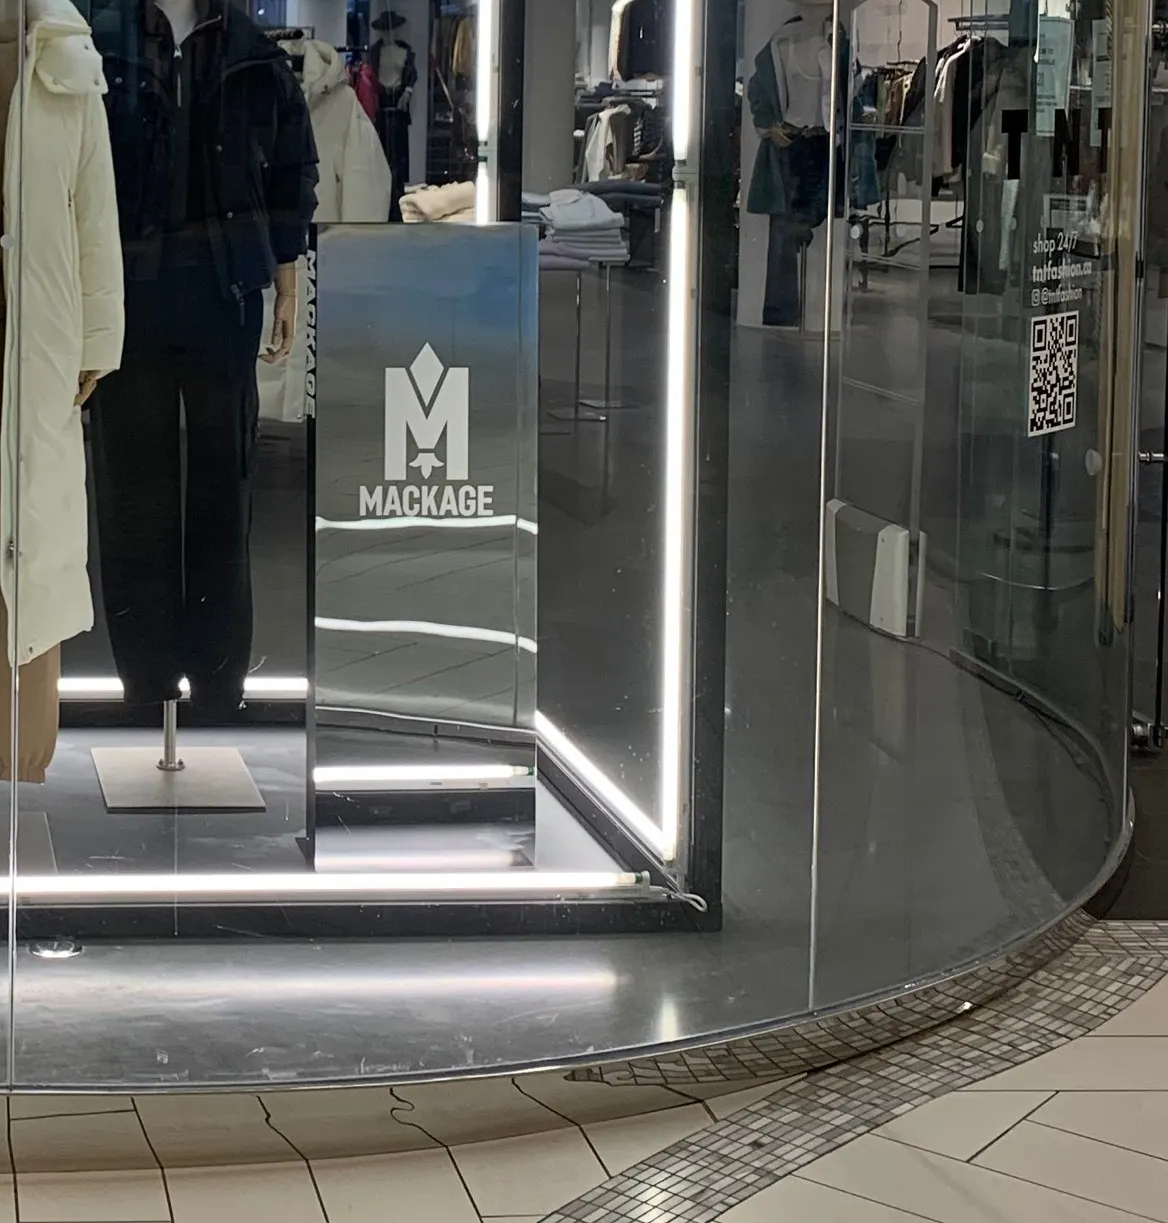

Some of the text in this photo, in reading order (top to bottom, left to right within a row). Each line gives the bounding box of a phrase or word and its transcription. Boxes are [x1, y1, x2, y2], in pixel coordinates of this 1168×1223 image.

[1033, 231, 1078, 257] shop 24/7
[1032, 259, 1092, 282] tntfashion.ca
[1041, 284, 1082, 305] @tntfashion
[359, 485, 494, 516] MACKAGE
